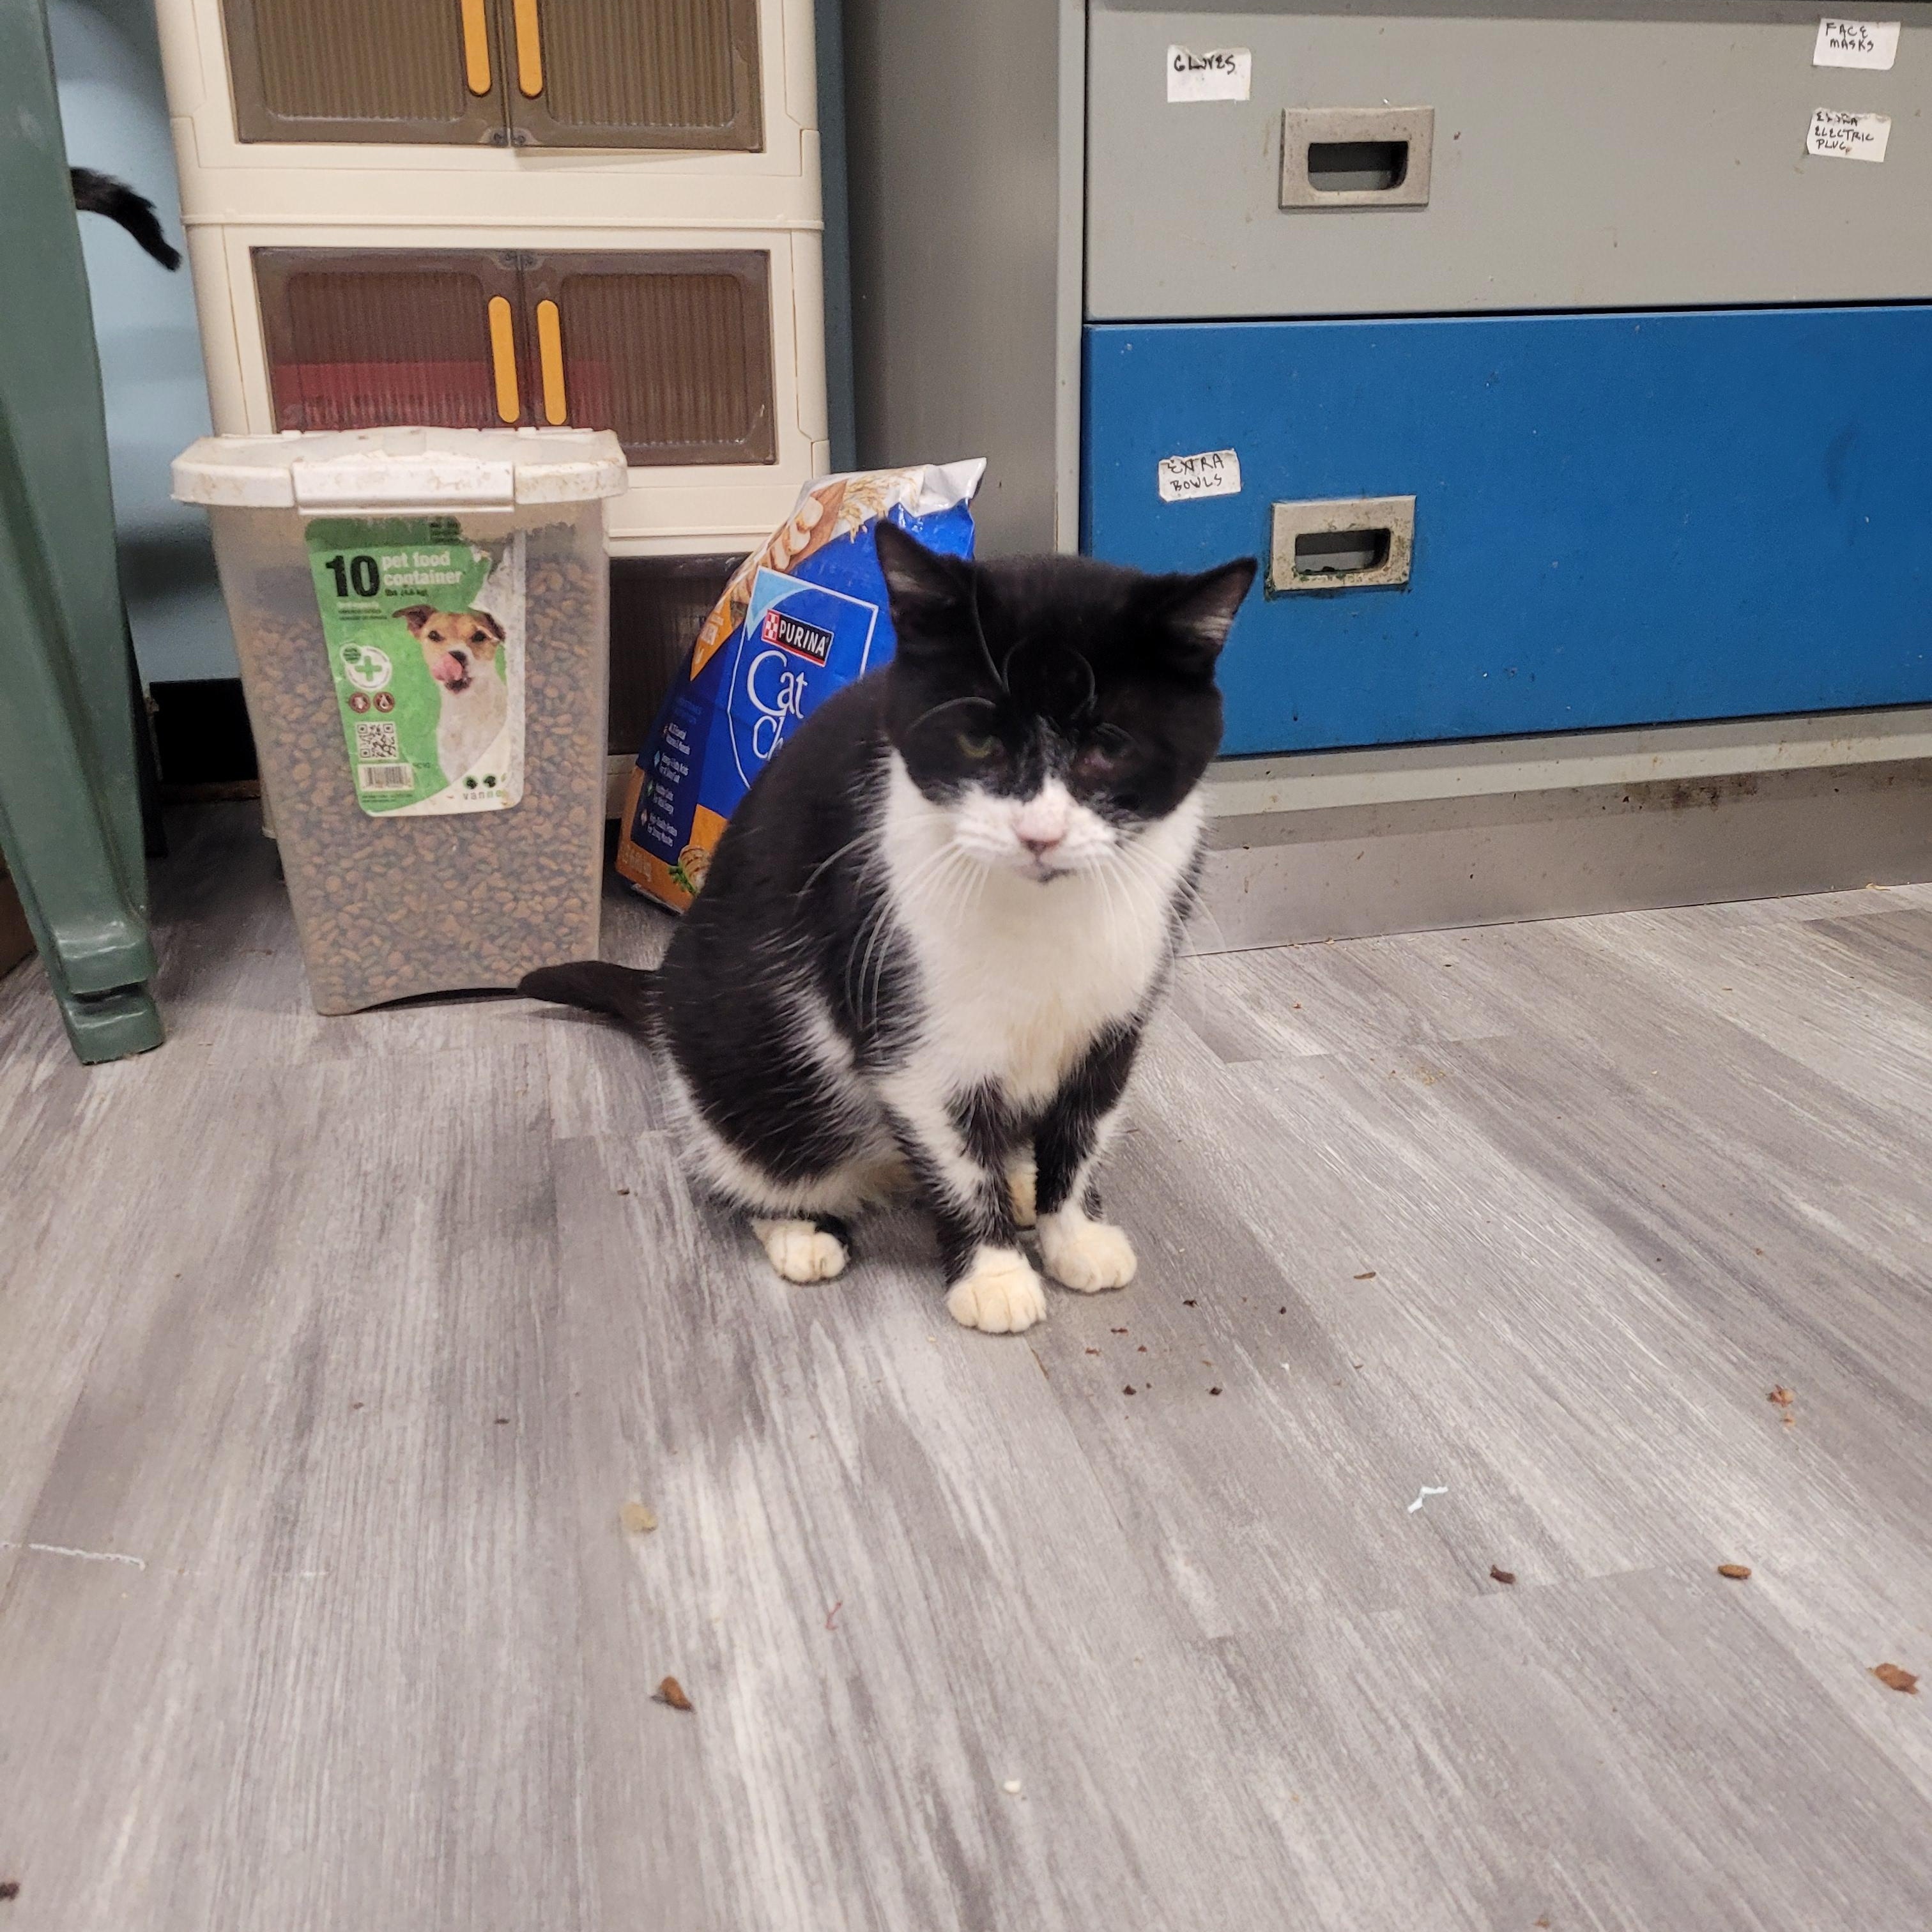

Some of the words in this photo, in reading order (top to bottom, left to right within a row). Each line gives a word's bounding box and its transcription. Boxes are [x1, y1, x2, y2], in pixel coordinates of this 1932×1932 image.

[1825, 22, 1868, 39] FACE
[1830, 38, 1874, 52] MASKS
[1814, 125, 1874, 142] ELECTRIC
[1167, 453, 1224, 475] EXTRA
[1170, 473, 1222, 491] BOWLS
[381, 552, 408, 572] pet
[412, 550, 450, 568] food
[325, 555, 379, 597] 10
[384, 570, 463, 586] container
[778, 619, 827, 657] PURINA
[747, 650, 808, 719] Cat
[753, 714, 784, 762] Ch
